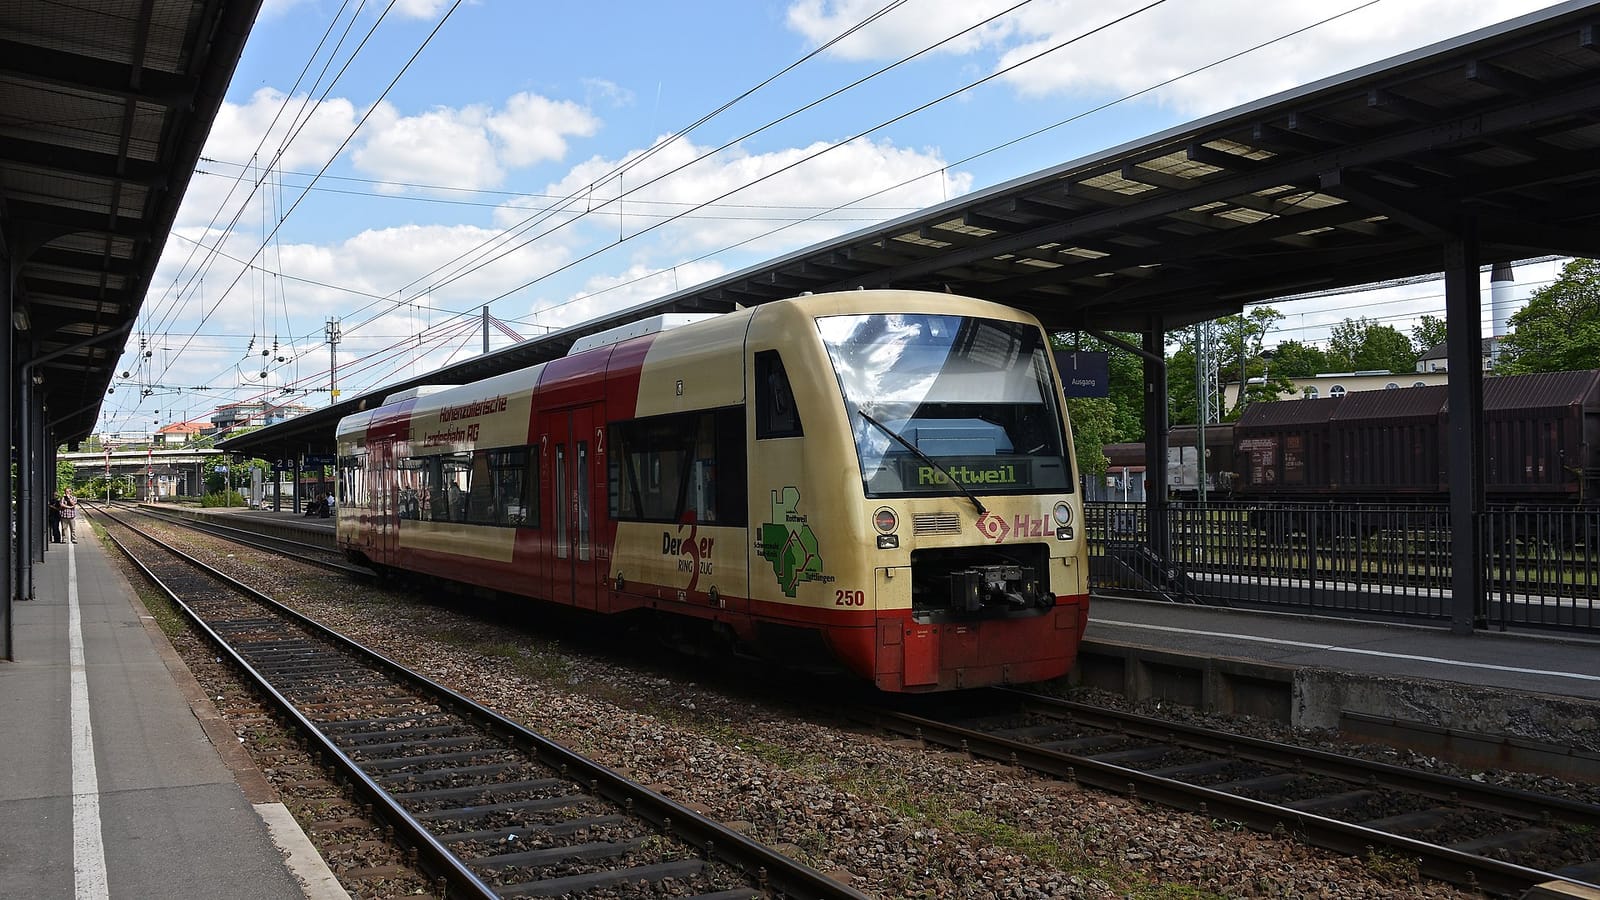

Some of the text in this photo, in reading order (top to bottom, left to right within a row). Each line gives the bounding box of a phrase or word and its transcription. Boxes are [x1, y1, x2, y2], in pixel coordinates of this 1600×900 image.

[1070, 352, 1077, 370] 1
[1071, 378, 1096, 387] Ausgang
[439, 394, 508, 423] Hohenzollerische
[466, 423, 480, 442] AG
[596, 428, 604, 453] 2
[541, 435, 548, 457] 2
[918, 465, 1016, 485] Rottweil
[1013, 514, 1055, 538] HzL
[662, 532, 682, 556] Der
[678, 559, 713, 575] RING ZUG
[835, 589, 865, 607] 250
